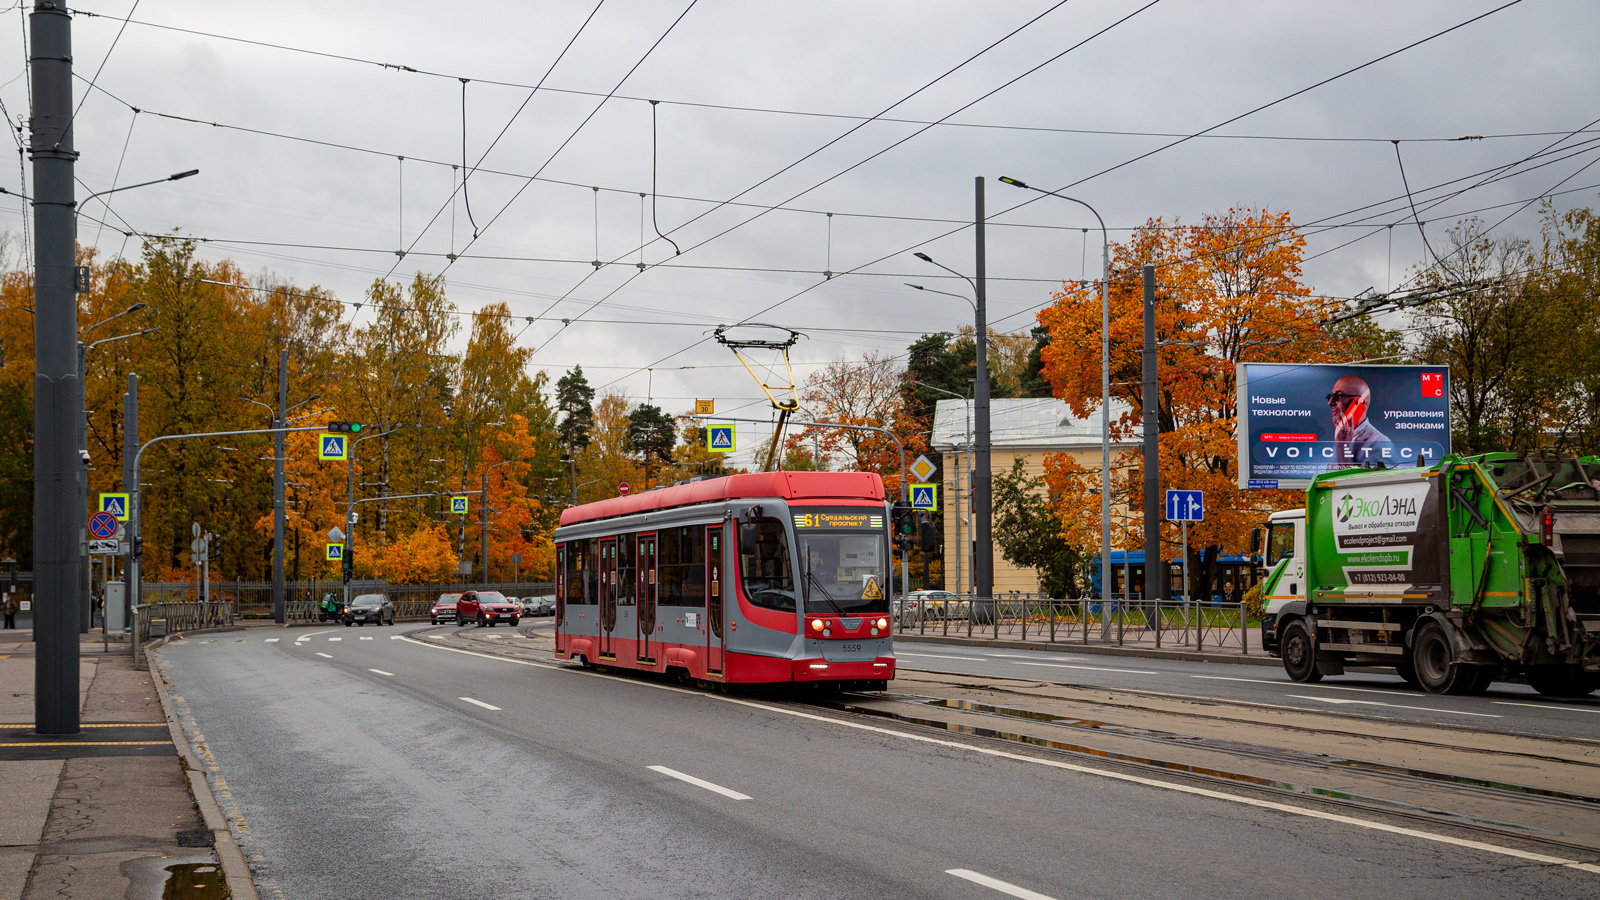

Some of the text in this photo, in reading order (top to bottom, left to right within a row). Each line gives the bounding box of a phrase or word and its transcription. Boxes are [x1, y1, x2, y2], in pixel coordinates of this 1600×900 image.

[1251, 395, 1287, 404] Новые
[1251, 409, 1311, 417] технологии
[1383, 410, 1444, 419] управления
[1395, 422, 1445, 430] звонками
[804, 513, 867, 527] 61 Суздальский
[1368, 521, 1393, 530] обработка
[1394, 520, 1415, 528] отходов
[1343, 535, 1407, 546] ecolendproject@gmail.com
[1347, 553, 1400, 564] www.ekolendspb.ru
[1354, 573, 1406, 583] +7 (812) 923-04-00
[842, 644, 862, 652] 5559
